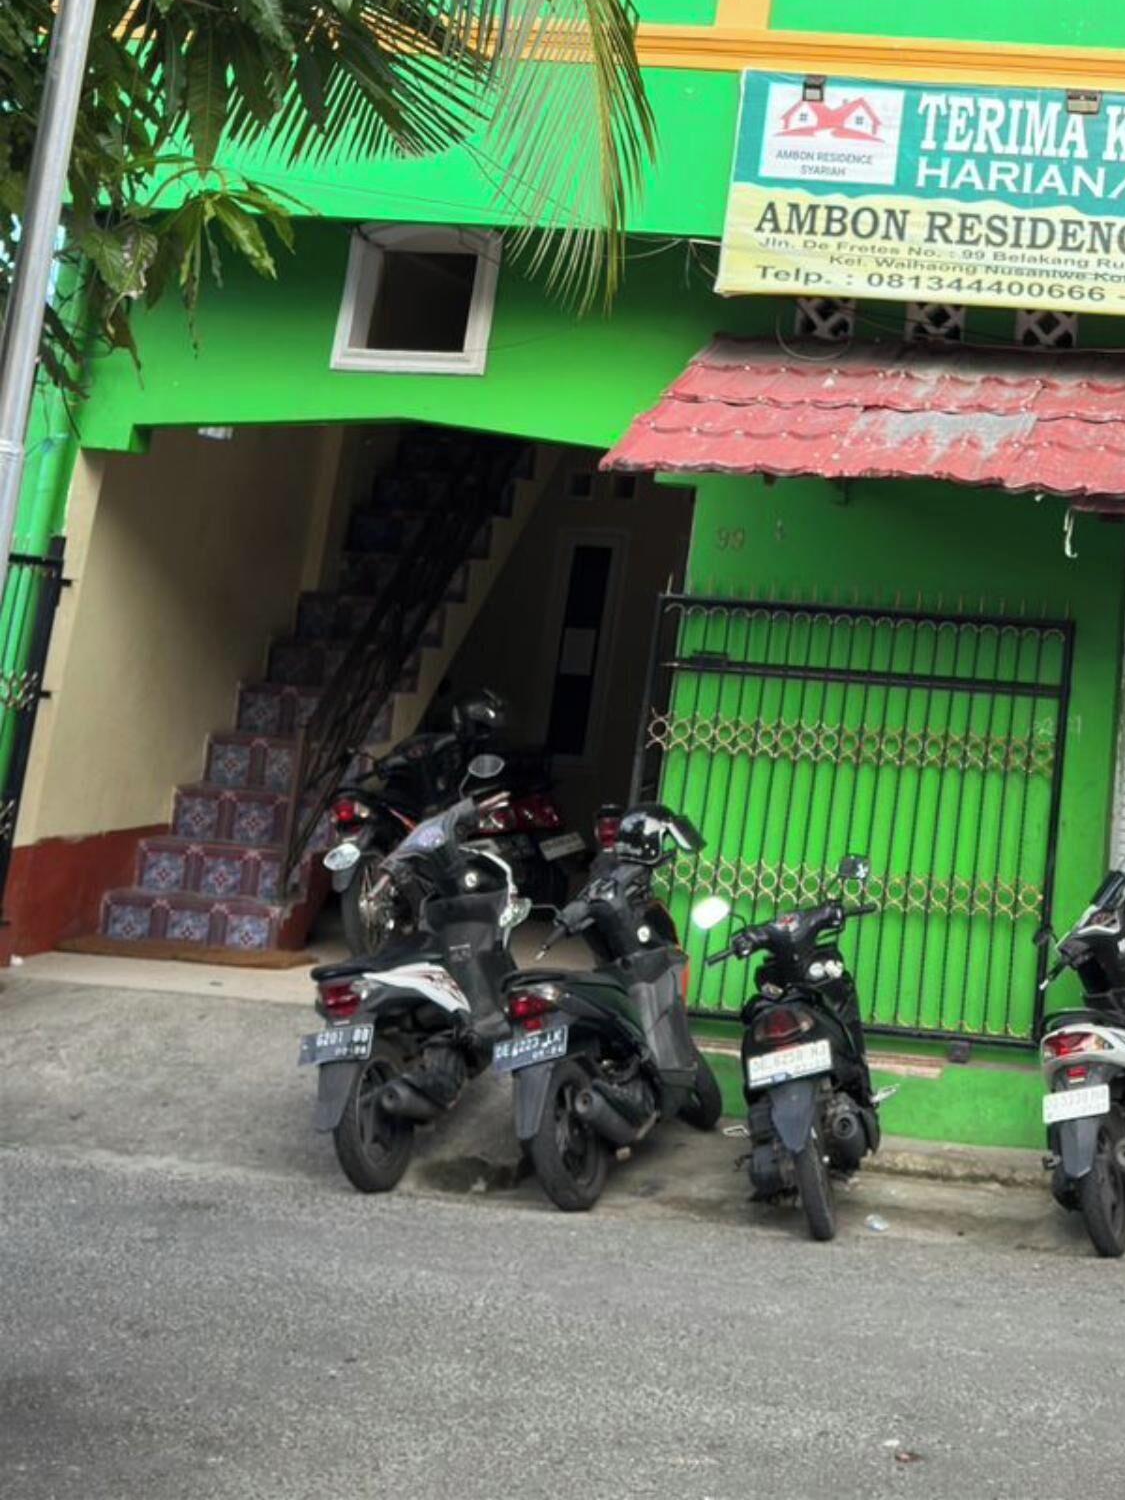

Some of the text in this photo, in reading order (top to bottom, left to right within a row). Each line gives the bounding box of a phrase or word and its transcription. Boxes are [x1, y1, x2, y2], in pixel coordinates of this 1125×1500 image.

[917, 91, 1088, 159] TERIMA
[775, 150, 873, 166] AMBON RESIDENCE
[800, 164, 847, 177] SYARIAH
[755, 201, 912, 241] AMBON
[758, 236, 793, 249] Jln.
[803, 238, 829, 251] De
[837, 241, 900, 256] Fretes
[907, 246, 942, 259] No.
[961, 248, 986, 261] 99
[992, 251, 1089, 270] Belakang
[829, 254, 868, 267] Kel.
[875, 257, 978, 276] Waihaong
[755, 264, 833, 287] Telp.
[867, 272, 1107, 302] 081344400666
